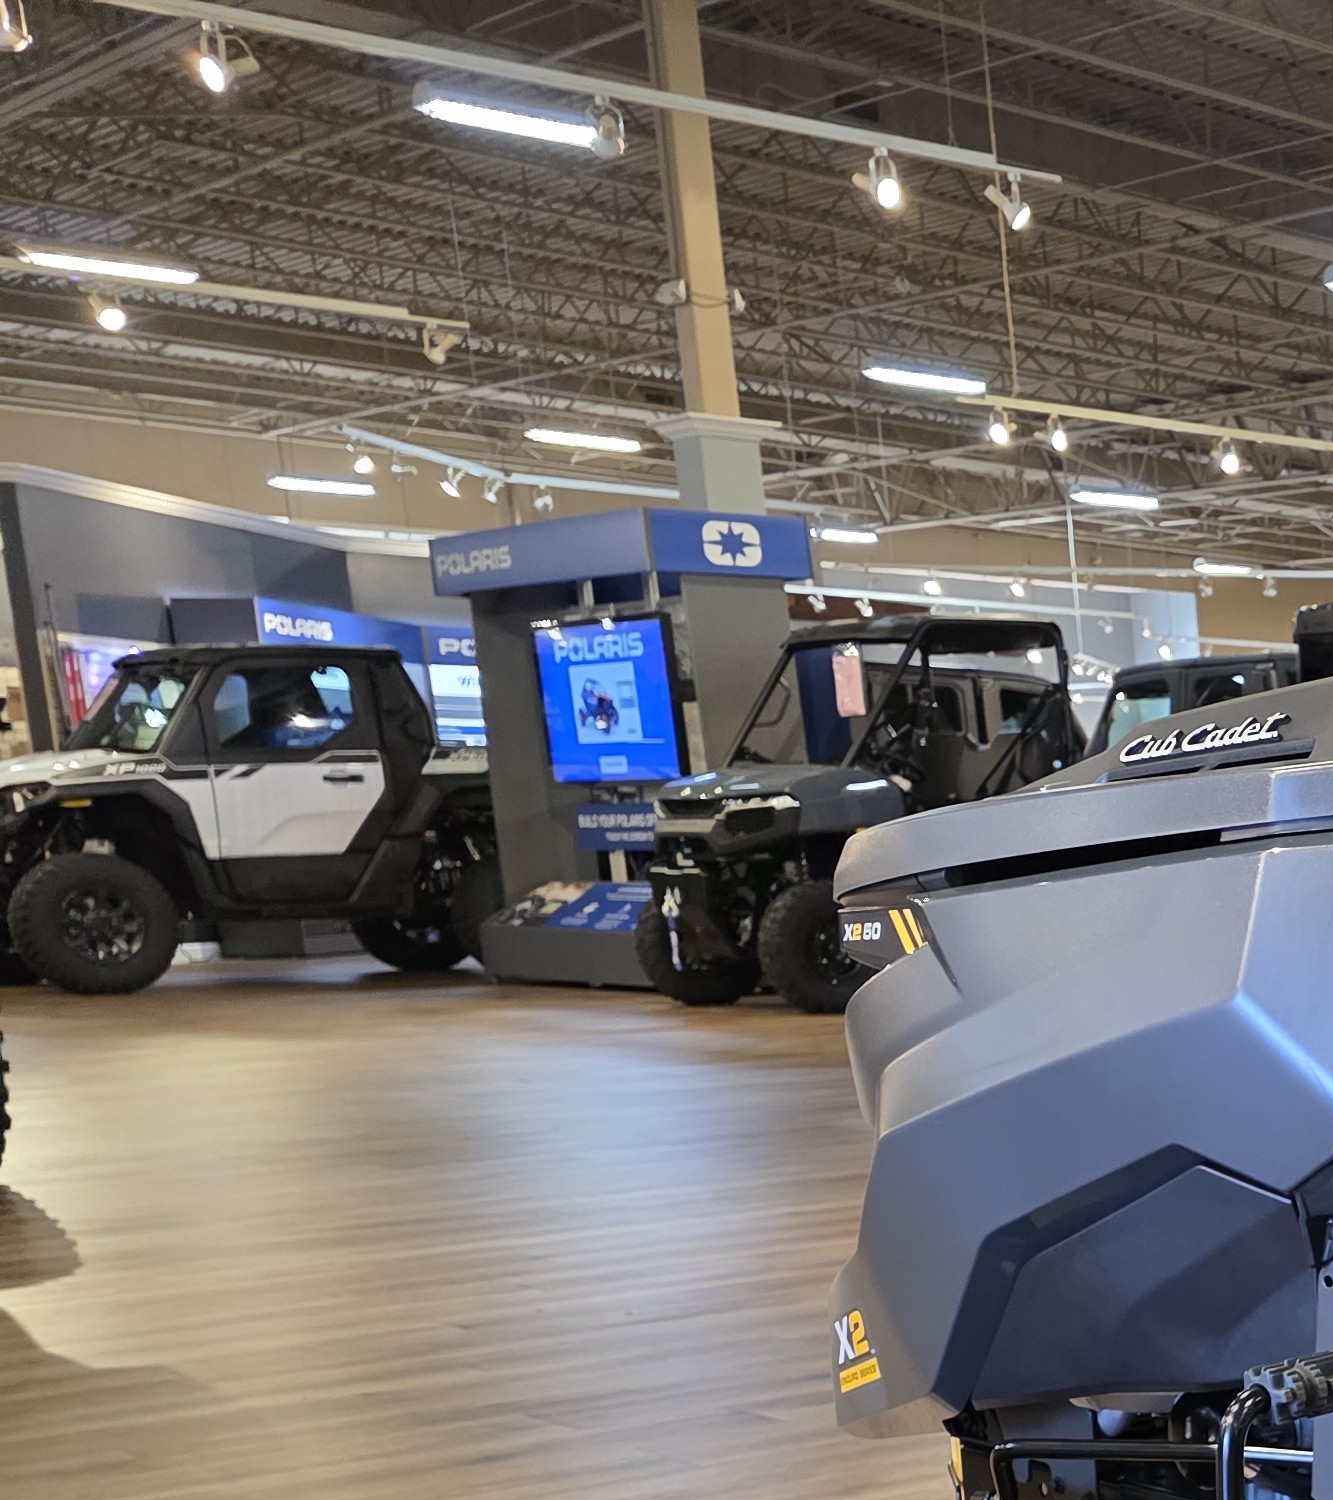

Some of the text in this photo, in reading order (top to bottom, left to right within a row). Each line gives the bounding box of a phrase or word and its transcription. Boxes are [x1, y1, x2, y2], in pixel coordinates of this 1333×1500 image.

[435, 544, 512, 578] POLARIS
[262, 612, 334, 642] POLARIS
[553, 631, 645, 664] POLARIS
[1119, 729, 1181, 762] Cub
[834, 1310, 870, 1365] X2
